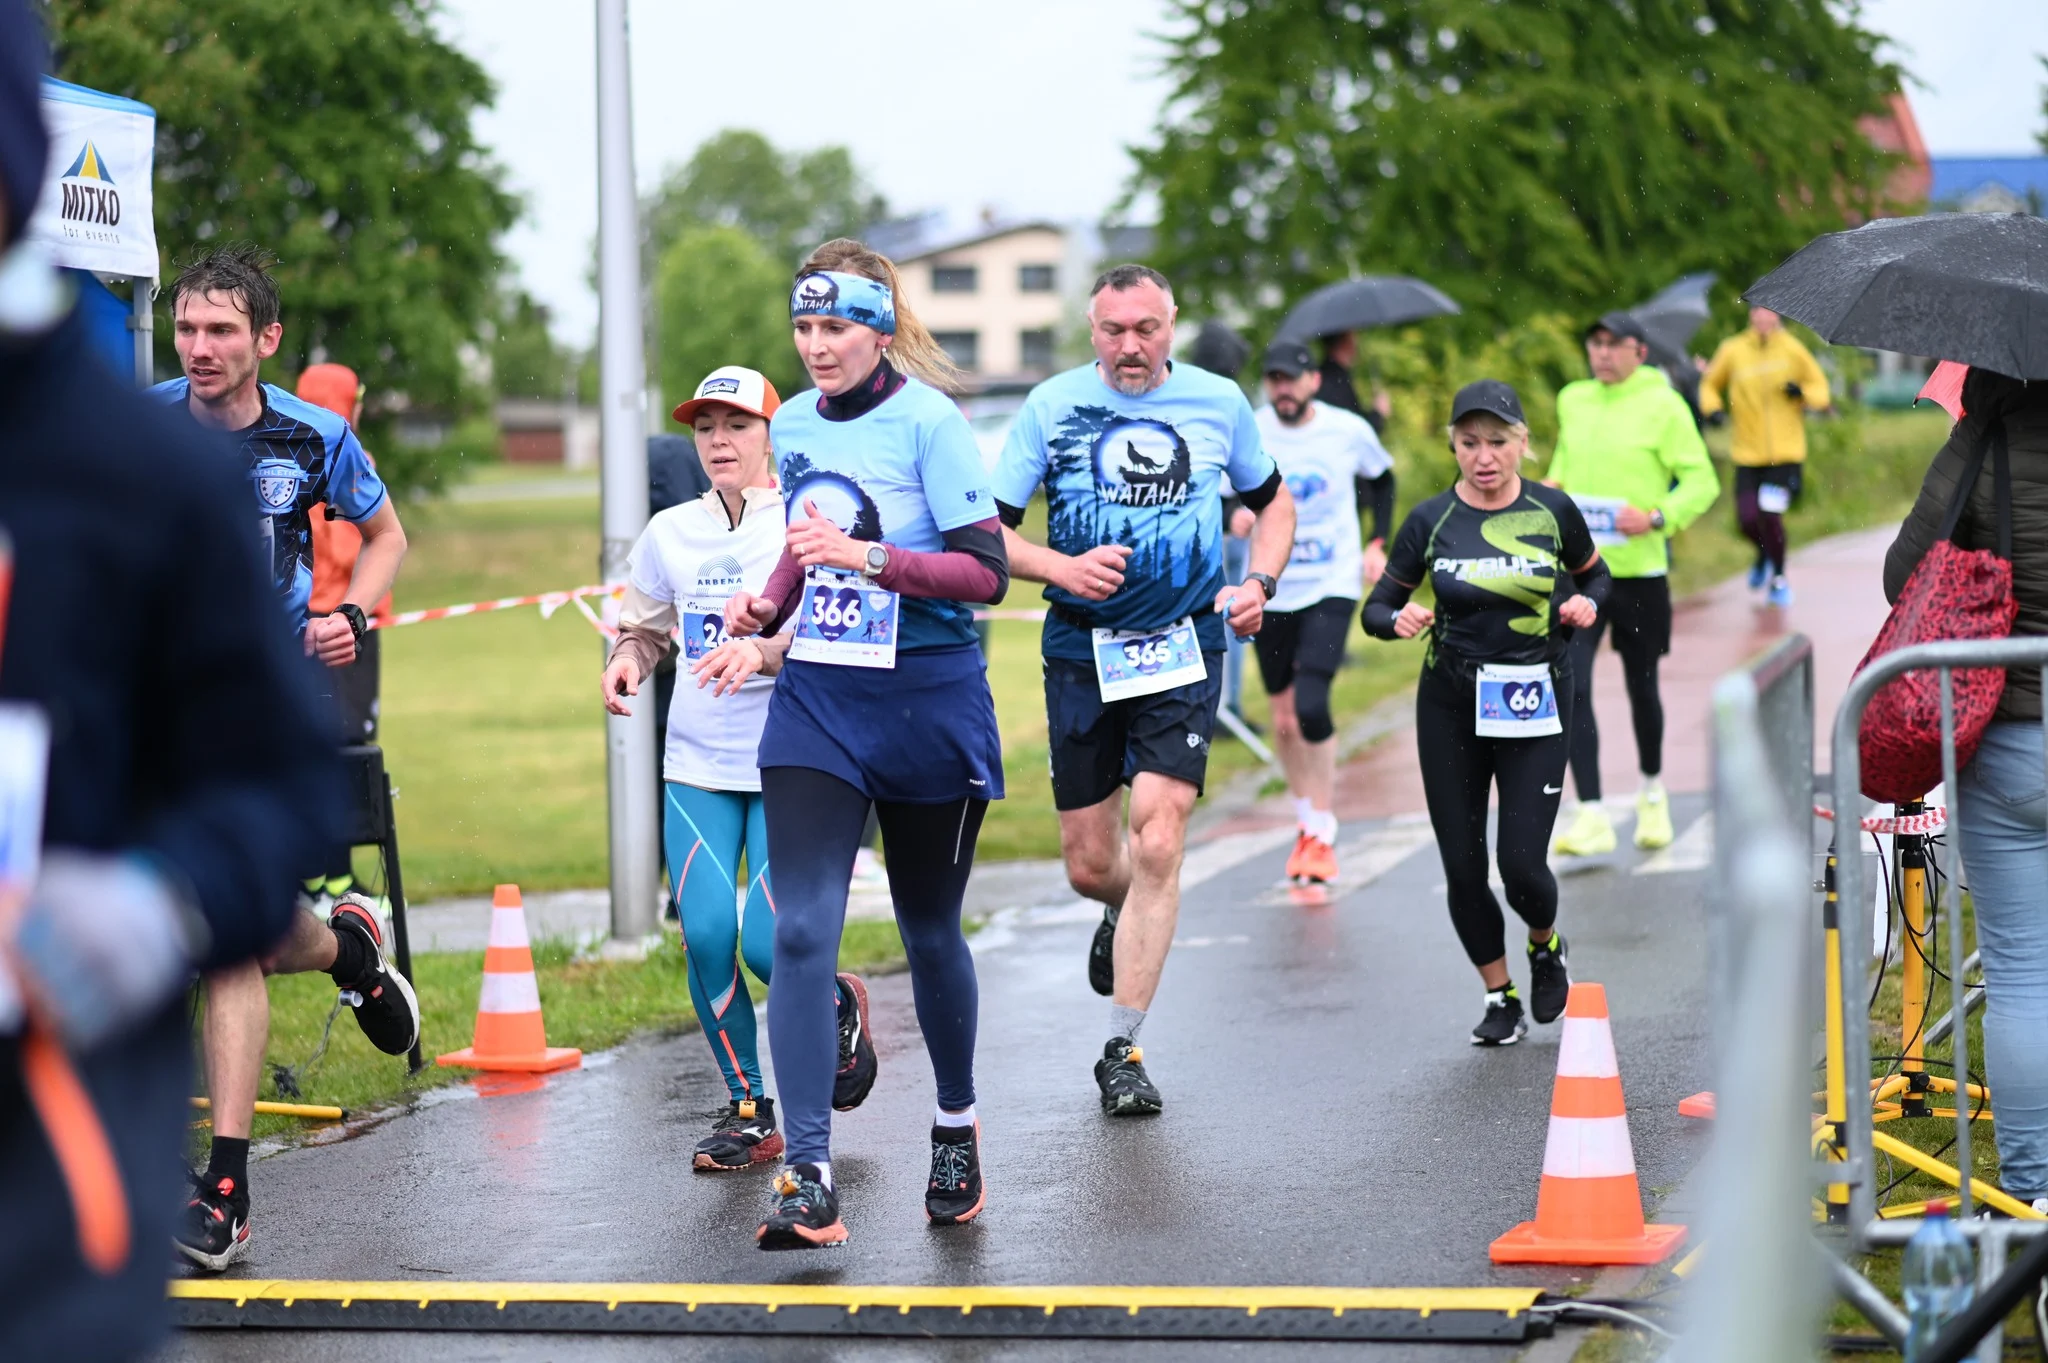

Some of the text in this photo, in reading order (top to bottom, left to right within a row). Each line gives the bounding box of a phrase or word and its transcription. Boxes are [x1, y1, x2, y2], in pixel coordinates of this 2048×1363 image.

[61, 183, 120, 226] MITKO
[63, 224, 120, 244] for events
[251, 469, 304, 477] ATHLETICS
[1096, 479, 1187, 506] WATAHA
[1433, 550, 1554, 573] PITBULL
[697, 577, 742, 586] ARBENA
[811, 596, 862, 628] 366
[703, 622, 751, 648] 26
[1124, 640, 1171, 668] 365
[1509, 687, 1540, 711] 66
